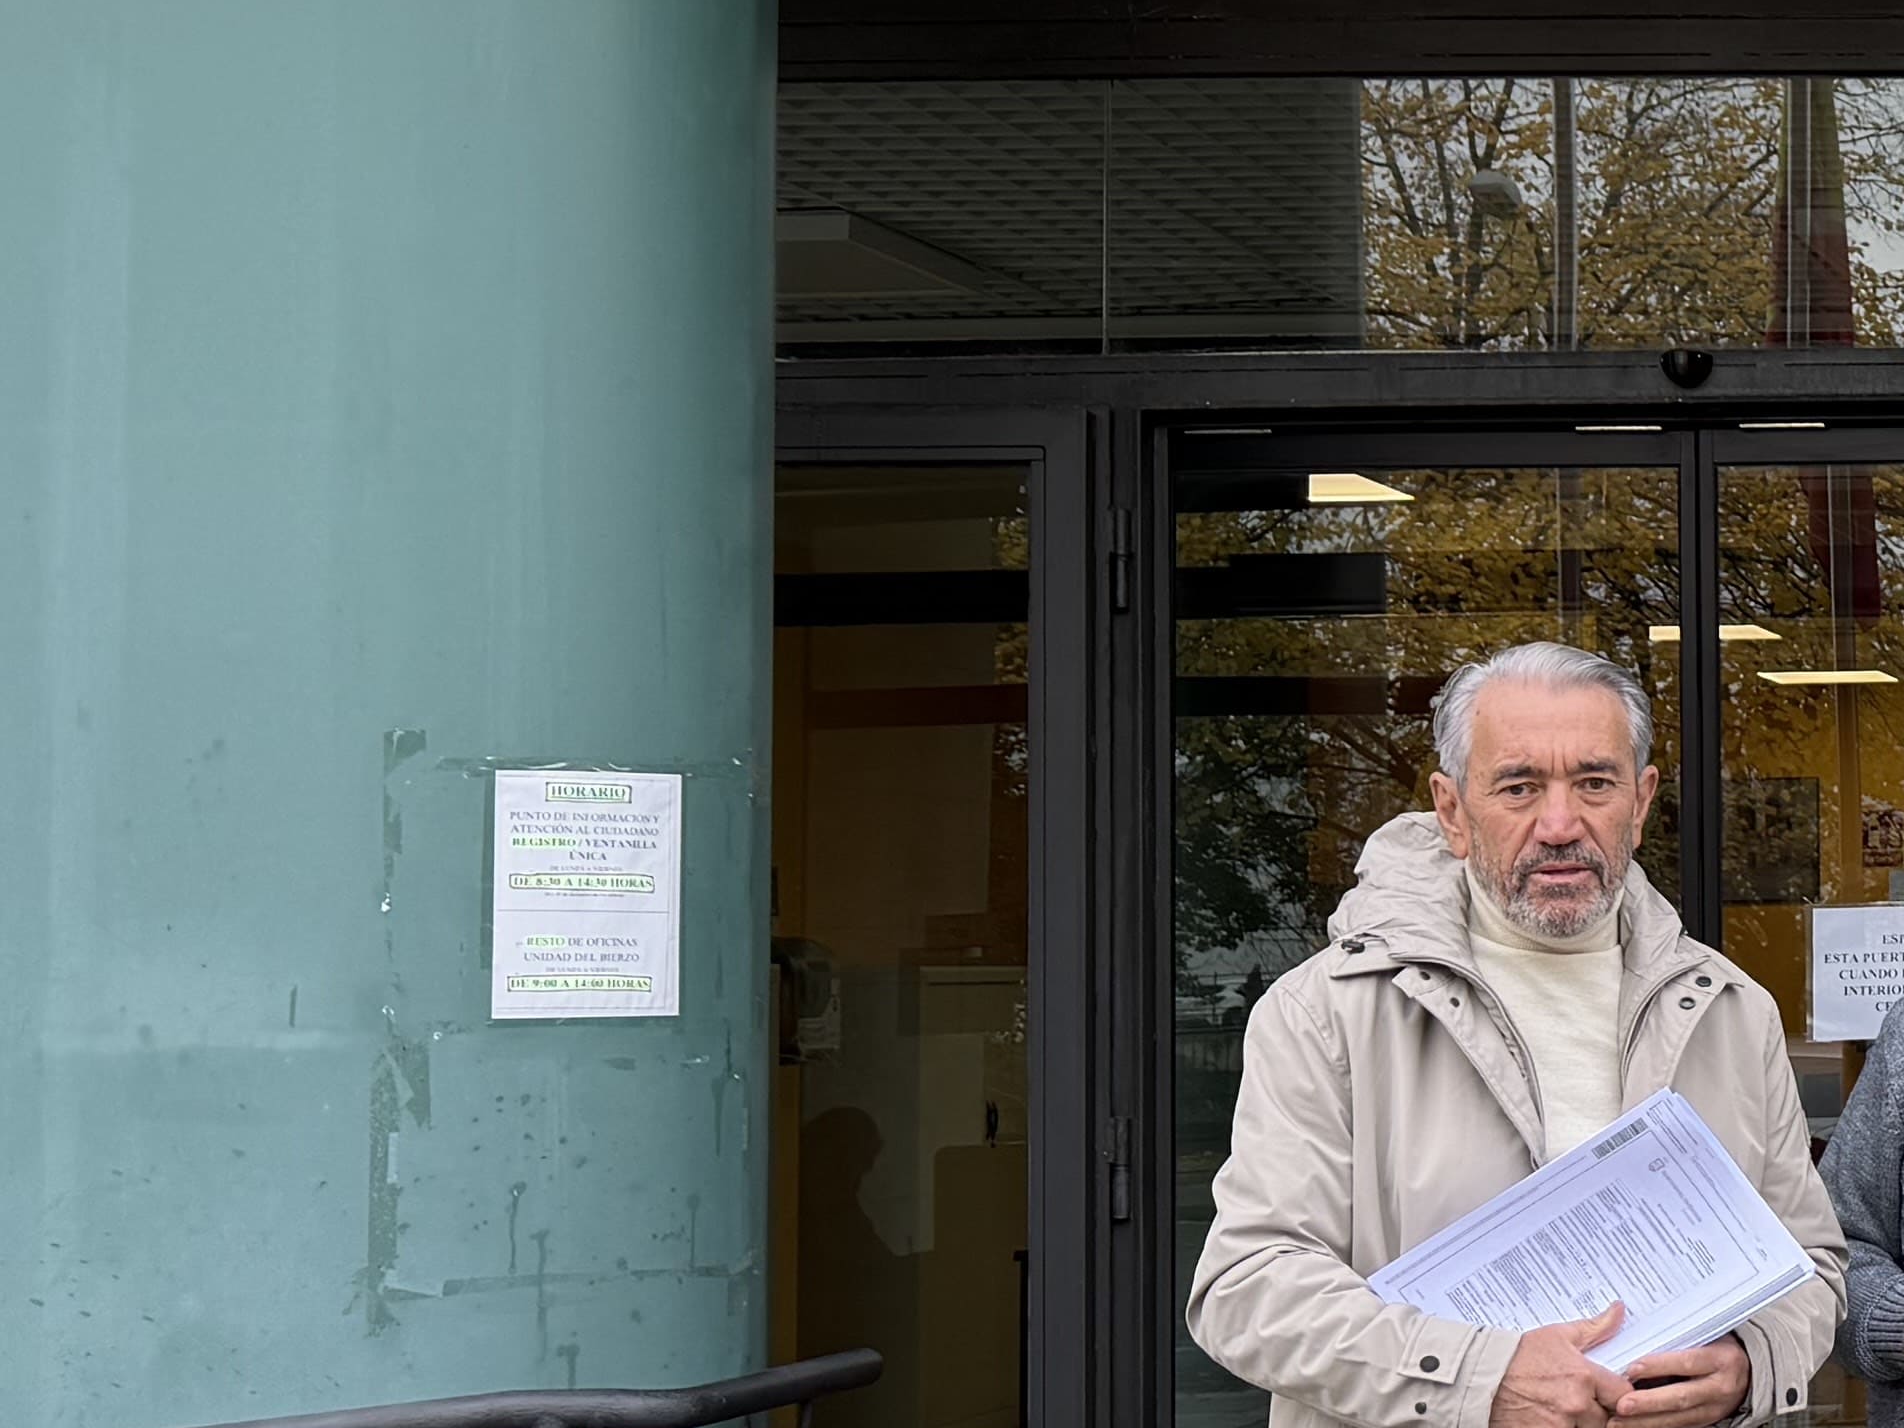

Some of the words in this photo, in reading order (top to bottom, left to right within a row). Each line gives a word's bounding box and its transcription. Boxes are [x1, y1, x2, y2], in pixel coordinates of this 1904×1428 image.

[551, 785, 626, 798] HORARIO
[510, 811, 551, 822] PUNTO
[554, 811, 567, 822] DE
[510, 822, 573, 835] ATENCIÓN
[575, 824, 592, 835] AL
[593, 825, 660, 837] CIUDADANO
[512, 836, 576, 847] REGISTRO
[585, 838, 657, 850] VENTANILLA
[514, 877, 530, 886] DE
[610, 877, 653, 888] HORAS
[527, 937, 565, 946] RESTO
[568, 937, 583, 946] DE
[586, 938, 638, 947] OFICINAS
[523, 952, 571, 962] UNIDAD
[574, 952, 597, 962] DEL
[600, 952, 640, 962] BIERZO
[1824, 952, 1859, 964] ESTA
[1839, 968, 1898, 980] CUANDO
[511, 979, 529, 988] DE
[607, 979, 650, 989] HORAS
